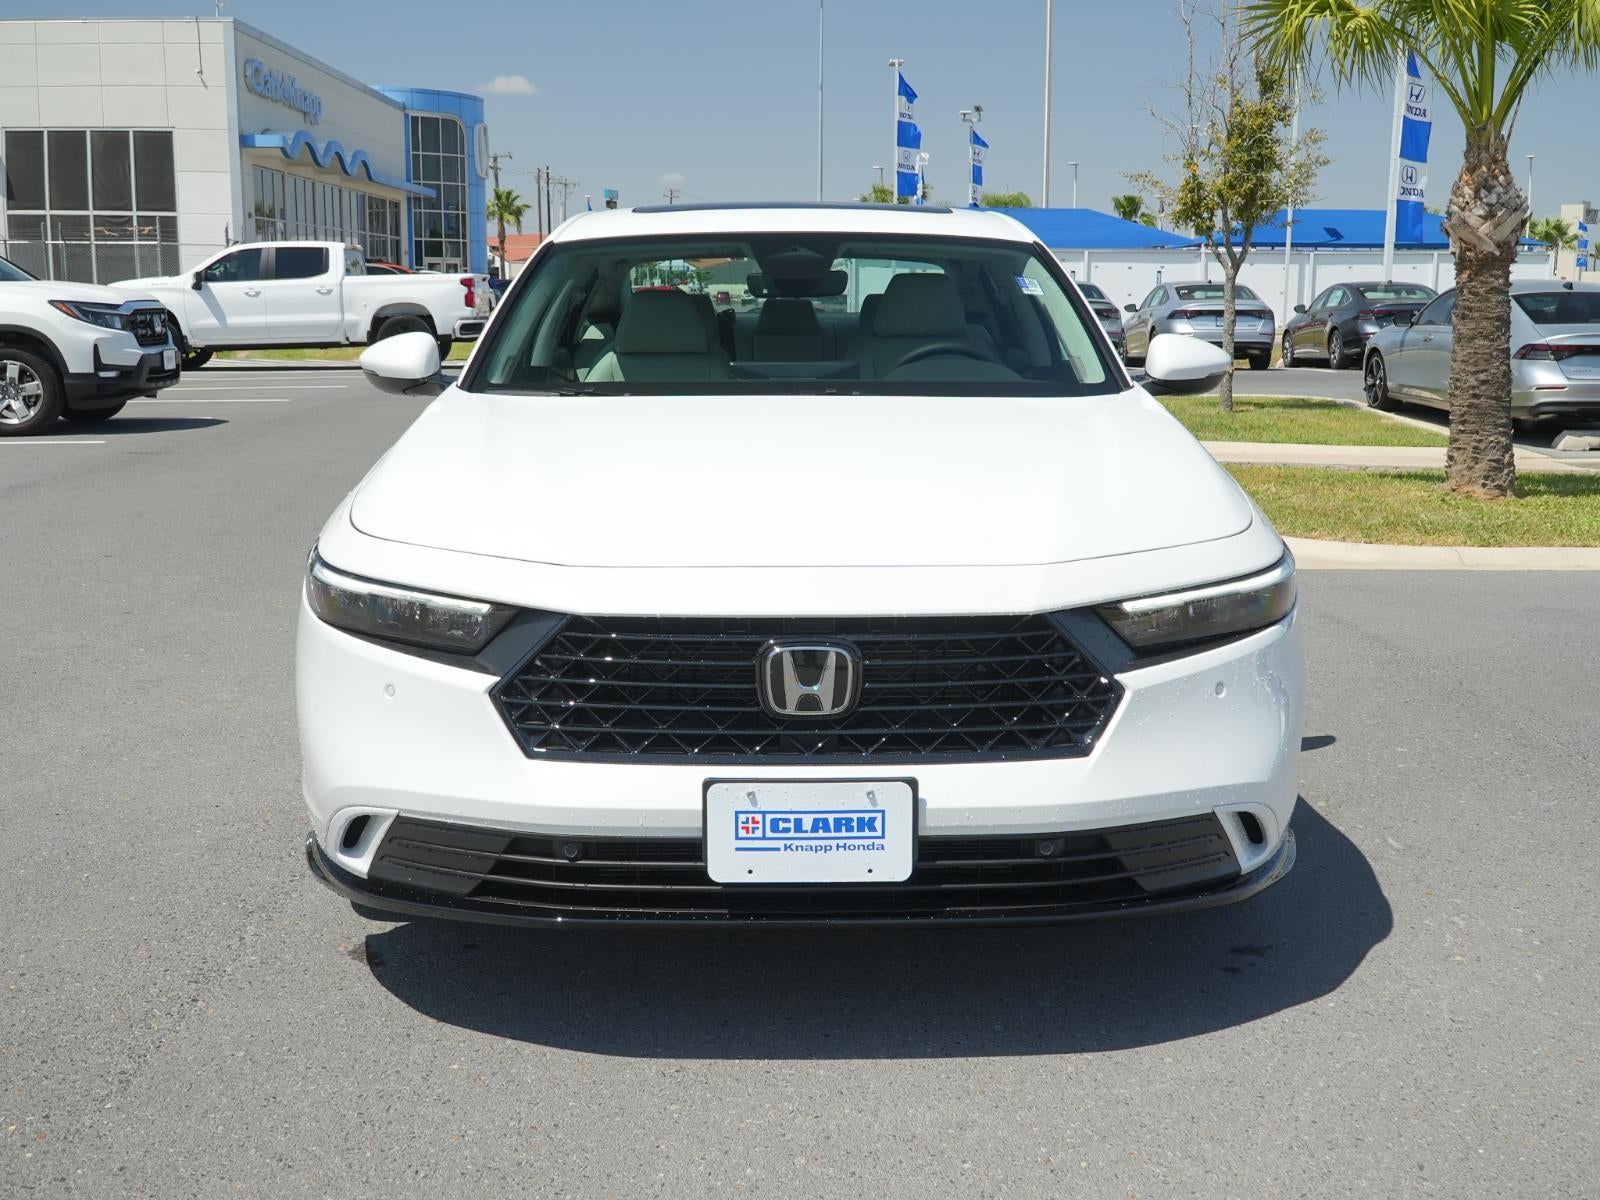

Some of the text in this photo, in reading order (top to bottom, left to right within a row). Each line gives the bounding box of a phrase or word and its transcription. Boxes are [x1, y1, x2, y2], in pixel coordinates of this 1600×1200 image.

[1400, 186, 1425, 198] ONDA
[769, 816, 879, 834] CLARK
[783, 841, 886, 854] Knapp Honda
